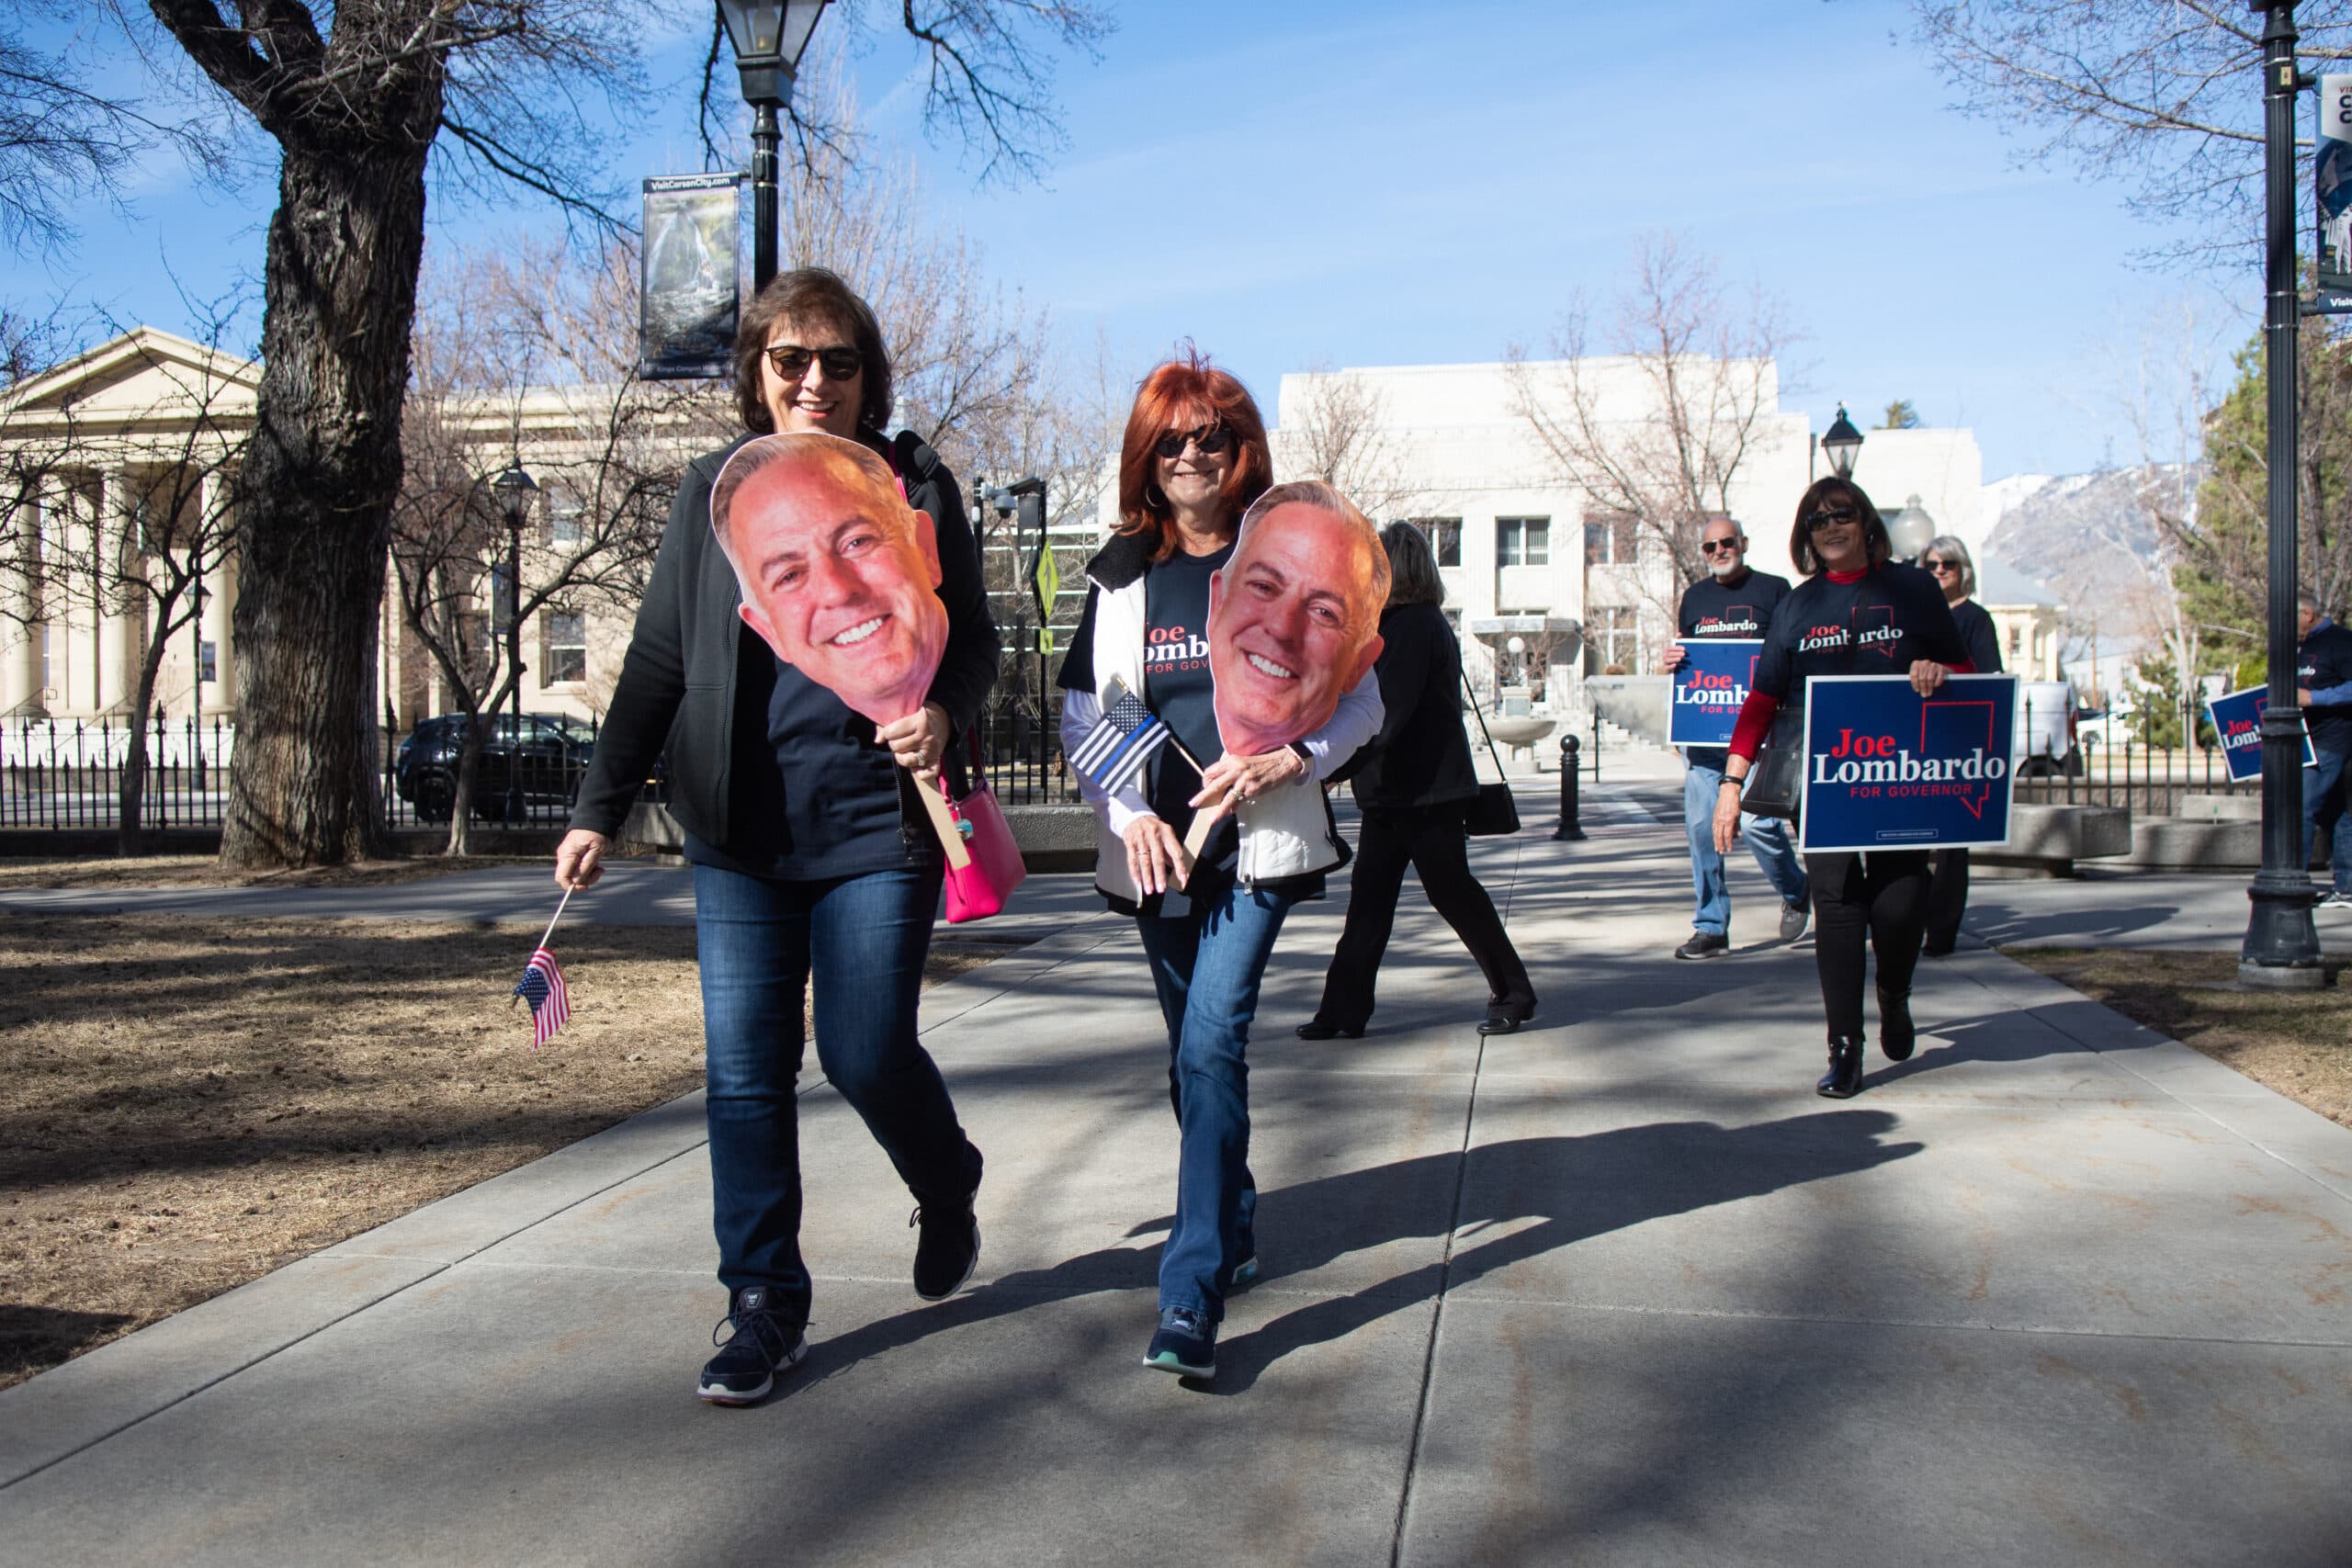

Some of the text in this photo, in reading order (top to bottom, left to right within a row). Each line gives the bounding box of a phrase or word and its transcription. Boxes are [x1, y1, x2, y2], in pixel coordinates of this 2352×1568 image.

[651, 177, 730, 191] VisitCarsonCity.com
[1695, 619, 1758, 634] Lombardo
[1700, 616, 1718, 626] Joe
[1147, 624, 1185, 643] oe
[1806, 625, 1840, 638] Joe
[1147, 663, 1174, 674] FOR
[1688, 670, 1733, 689] Joe
[1701, 705, 1723, 714] FOR
[2227, 719, 2253, 736] Joe
[1831, 728, 1896, 758] Joe
[1812, 748, 2006, 784] Lombardo
[1849, 784, 1973, 798] FOR GOVERNOR
